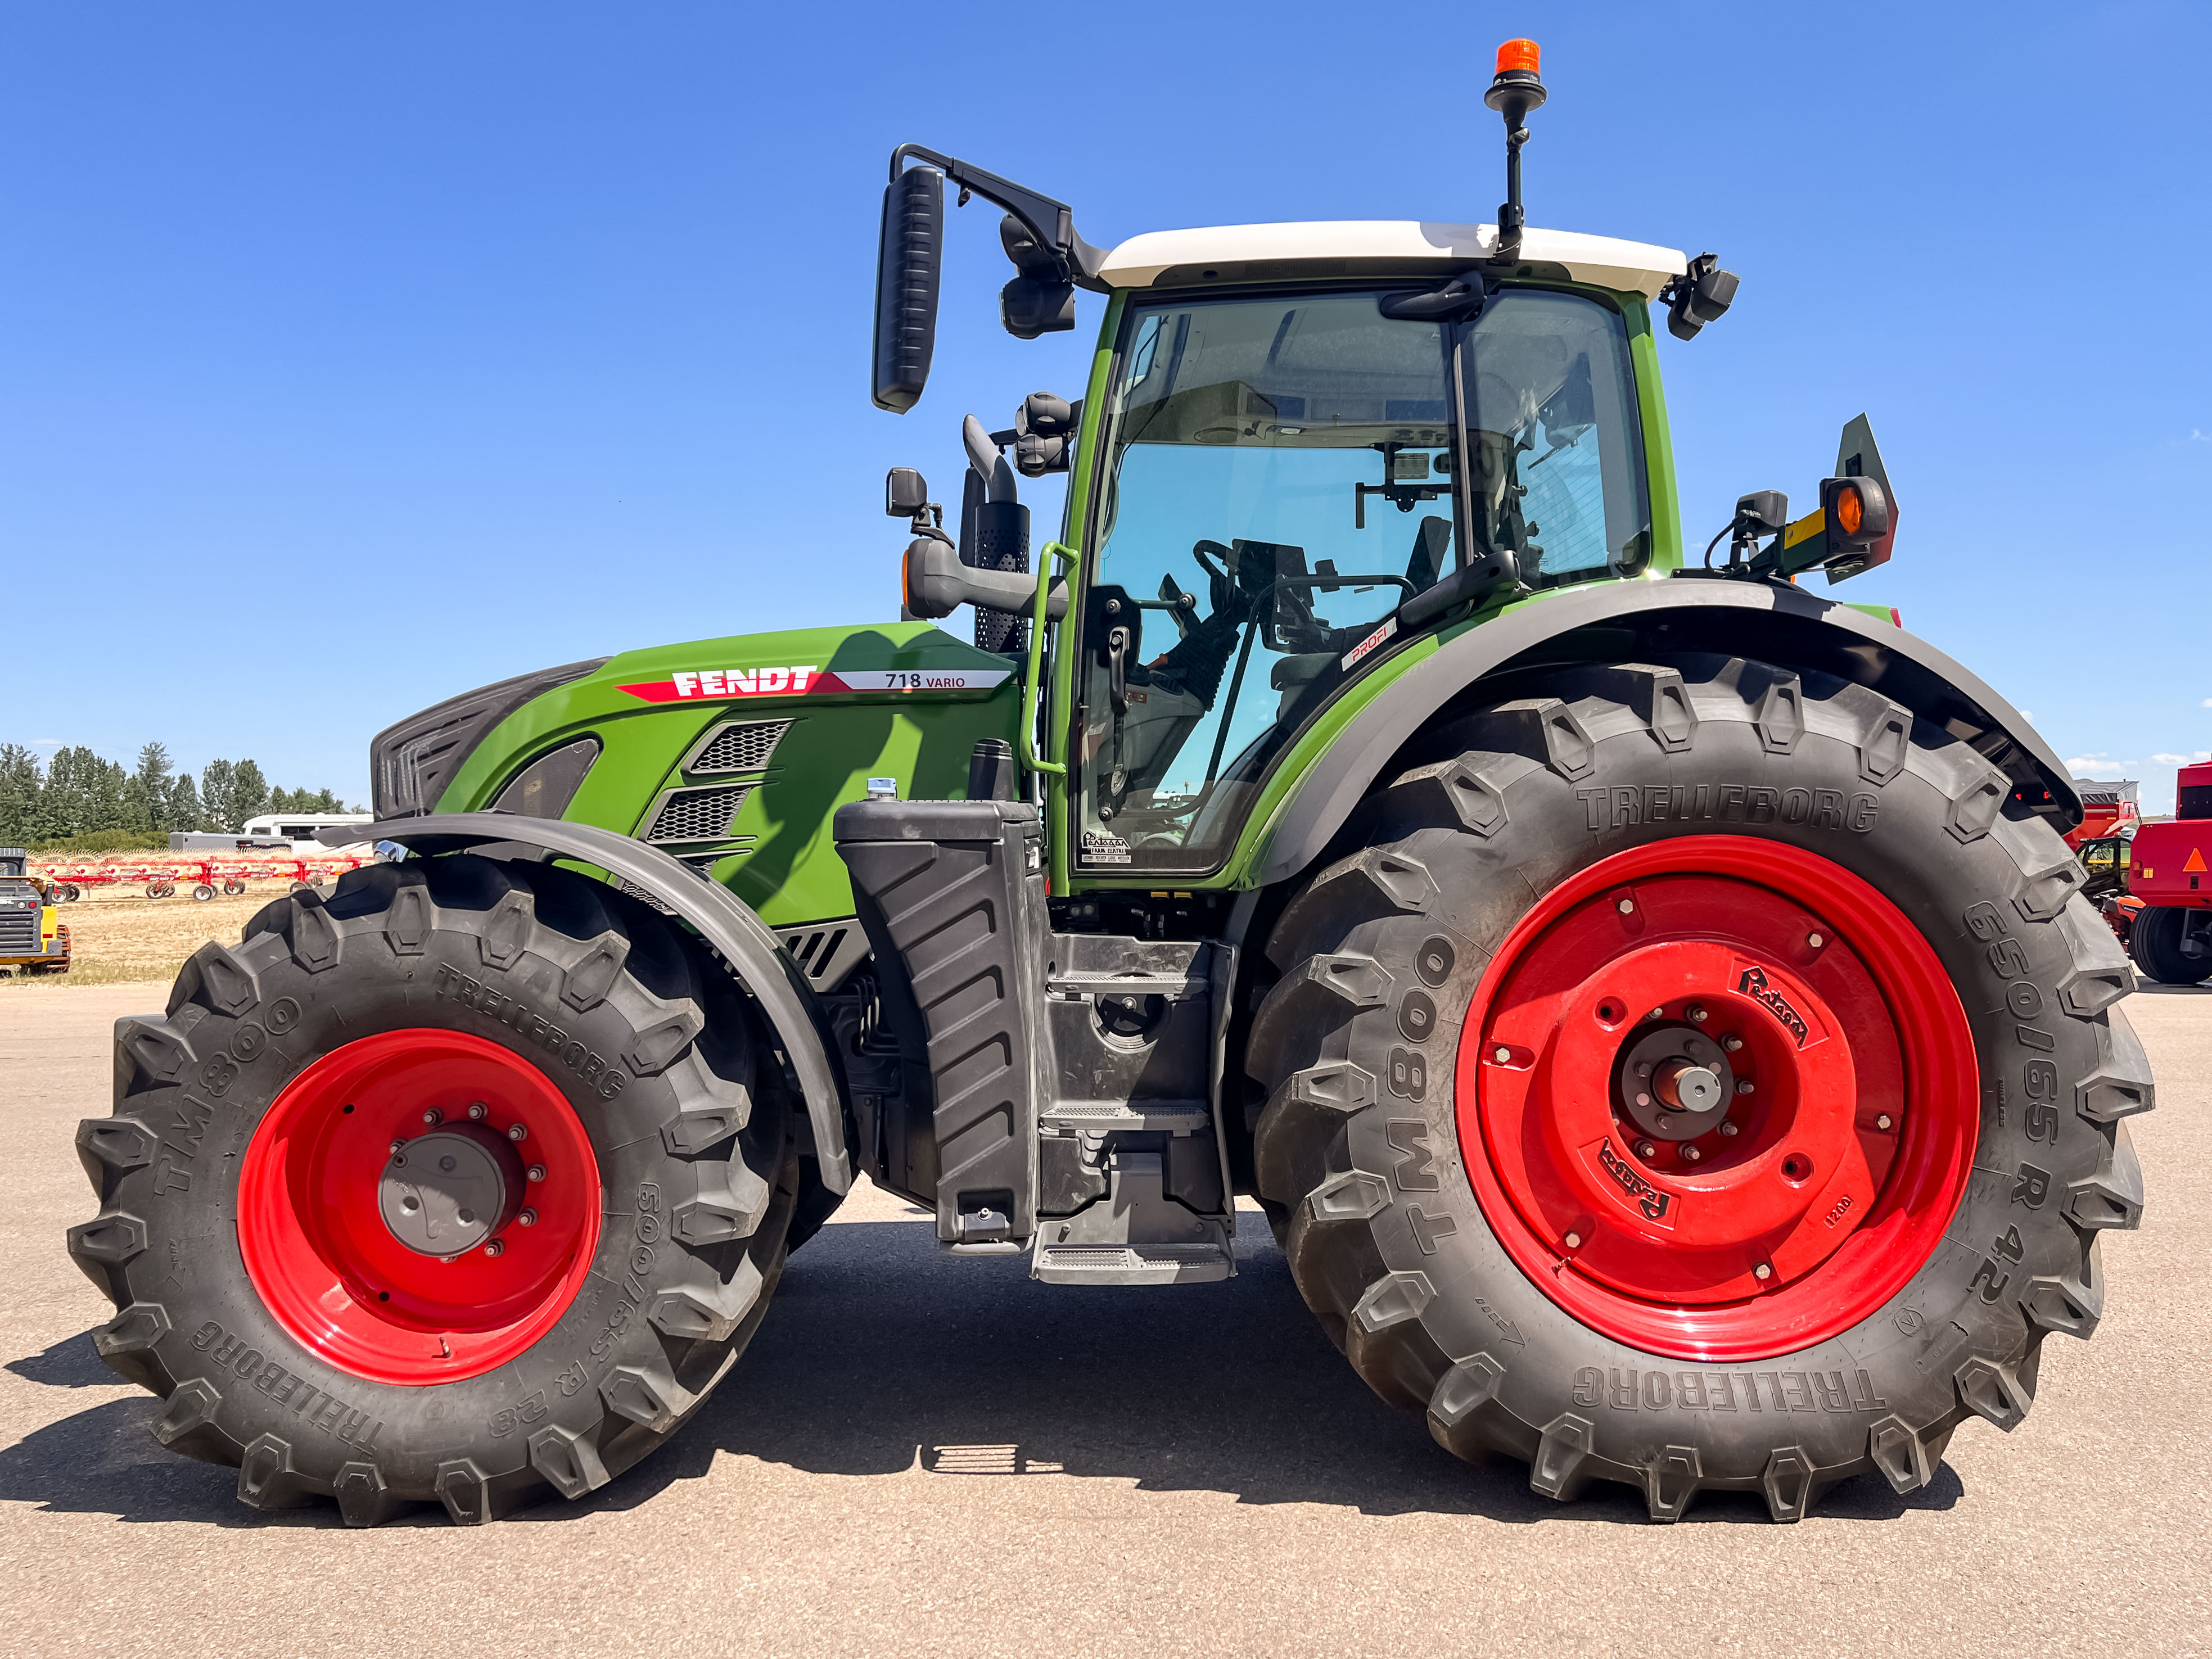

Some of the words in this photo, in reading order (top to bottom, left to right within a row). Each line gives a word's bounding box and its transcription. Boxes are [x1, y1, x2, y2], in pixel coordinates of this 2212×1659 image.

[1352, 626, 1387, 662] PROFI
[672, 665, 818, 697] FENDT
[886, 673, 921, 689] 718
[926, 677, 965, 688] VARIO
[1576, 784, 1880, 833] TRELLEBORG
[1083, 831, 1129, 848] Pentagon
[433, 962, 627, 1099] TRELLEBORG
[1963, 901, 2059, 1145] 650/65
[154, 996, 303, 1196] TM800
[1387, 933, 1457, 1255] TM800
[2011, 1160, 2052, 1210] R
[1966, 1223, 2025, 1305] 42
[190, 1321, 387, 1458] TRELLEBORG
[555, 1359, 589, 1397] R
[1573, 1366, 1888, 1413] TRELLEBORG
[488, 1389, 549, 1439] 28
